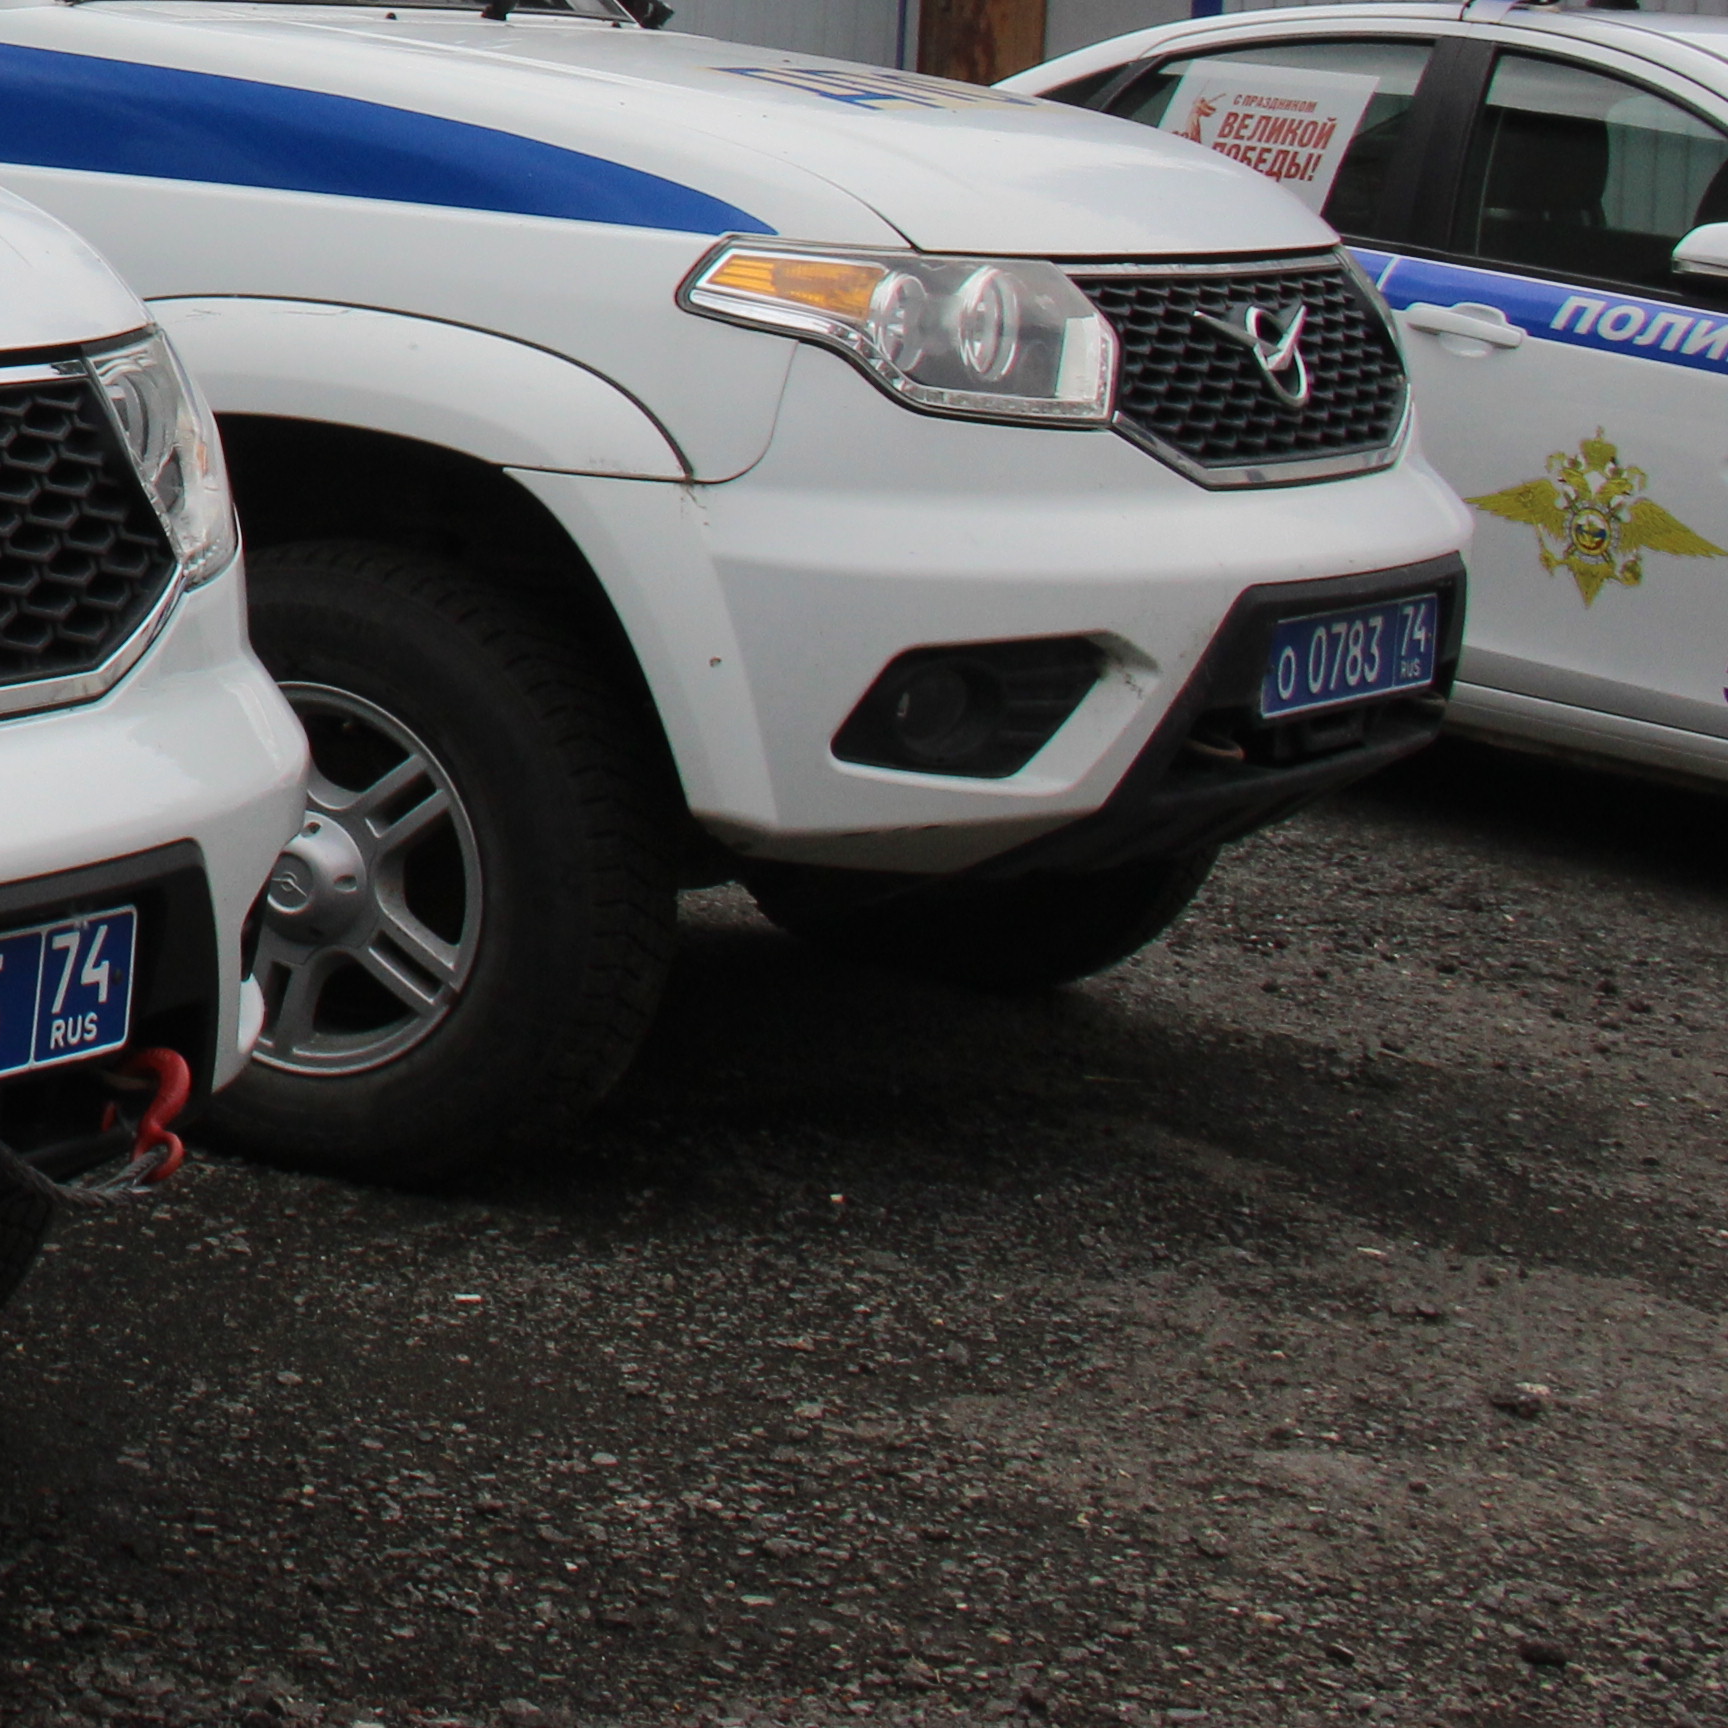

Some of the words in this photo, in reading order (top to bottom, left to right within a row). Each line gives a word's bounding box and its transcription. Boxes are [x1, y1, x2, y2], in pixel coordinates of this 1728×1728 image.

[1233, 95, 1243, 106] С
[1242, 95, 1318, 112] ПРАЗДНИКОМ
[1217, 111, 1337, 150] ВЕЛИКОЙ
[1550, 296, 1728, 362] ПОЛИ
[1277, 645, 1296, 700] О
[1308, 616, 1384, 694] 0783
[1401, 603, 1427, 657] 74
[1401, 659, 1422, 679] RUS
[51, 924, 110, 1015] 74
[49, 1012, 99, 1050] RUS
